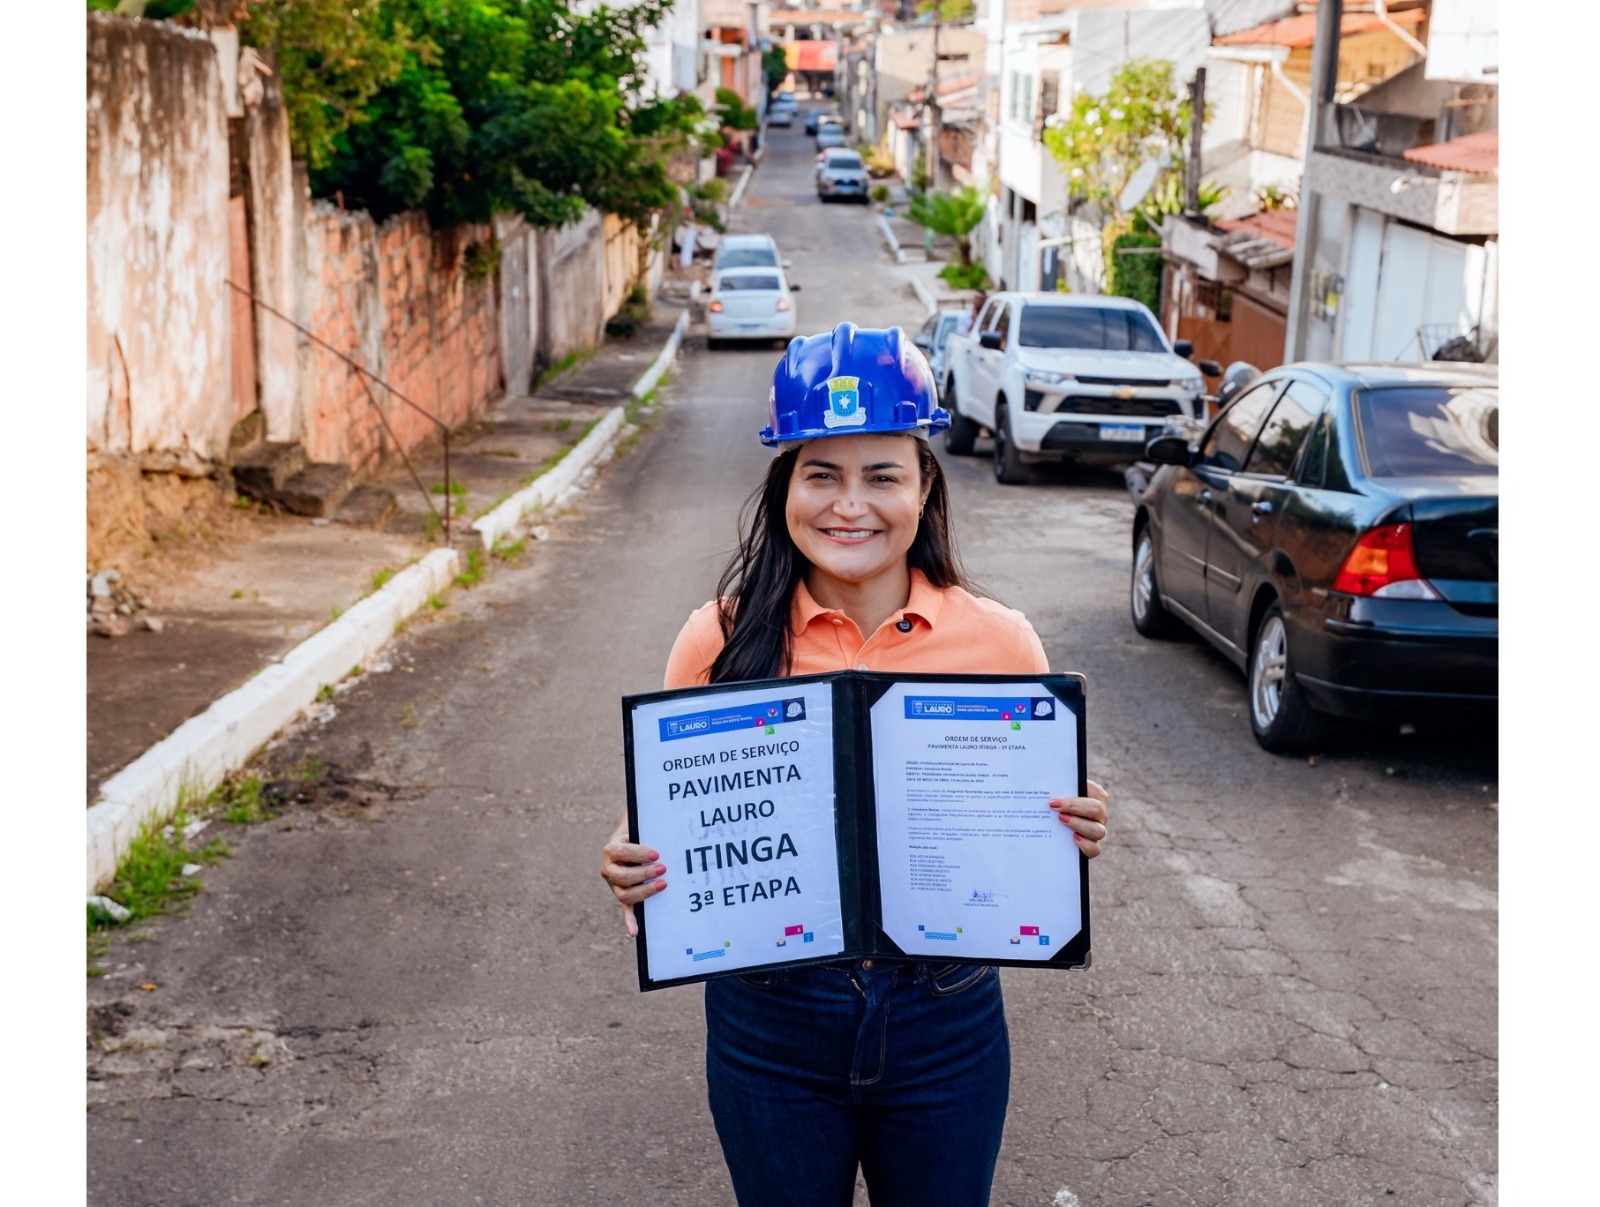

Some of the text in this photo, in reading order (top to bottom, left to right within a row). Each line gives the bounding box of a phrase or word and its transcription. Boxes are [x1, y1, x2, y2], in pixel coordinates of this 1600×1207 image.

[679, 721, 708, 732] LAURO
[662, 740, 800, 772] ORDEM DE SERVIÇO
[668, 764, 802, 800] PAVIMENTA
[700, 800, 774, 828] LAURO
[686, 832, 798, 874] ITINGA
[689, 876, 802, 912] 3ª ETAPA
